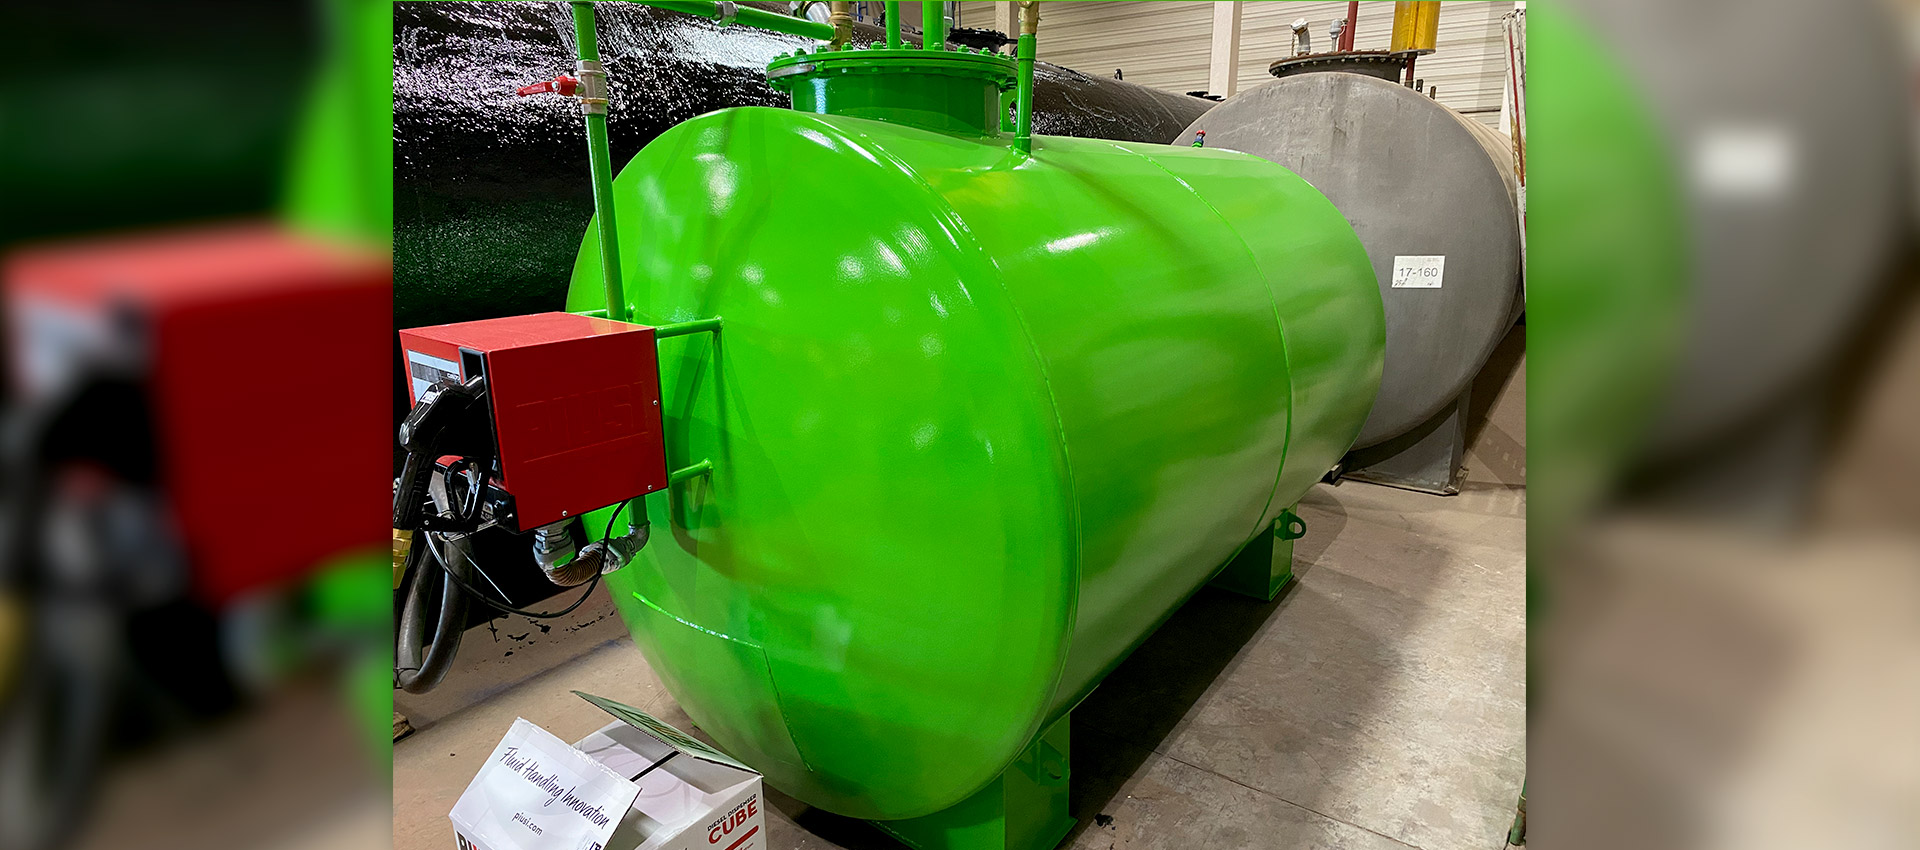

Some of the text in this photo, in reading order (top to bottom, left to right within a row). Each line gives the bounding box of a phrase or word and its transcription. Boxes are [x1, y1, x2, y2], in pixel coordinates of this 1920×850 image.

[1399, 266, 1439, 278] 17-160
[500, 746, 610, 830] Fluid Handling Innovation
[512, 812, 543, 836] piusi.com
[707, 793, 757, 831] DIESEL DISPENSER
[708, 799, 758, 844] CUBE
